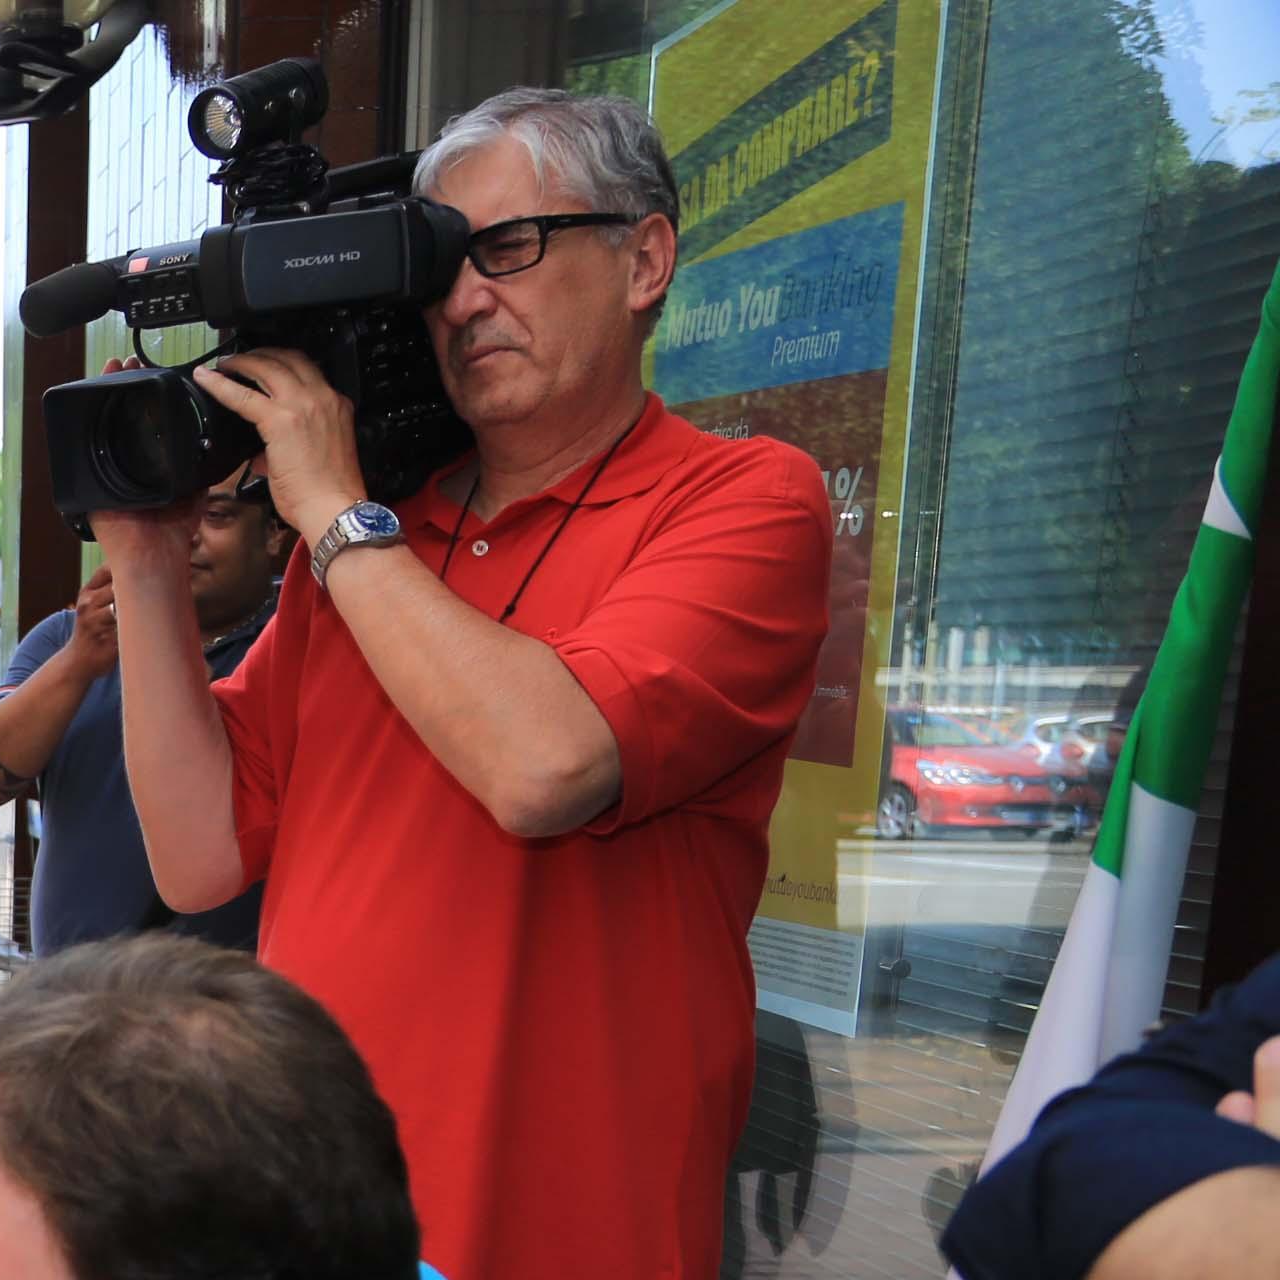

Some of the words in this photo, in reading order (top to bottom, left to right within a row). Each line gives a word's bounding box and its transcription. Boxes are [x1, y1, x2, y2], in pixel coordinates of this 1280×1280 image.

[679, 175, 701, 236] SA
[733, 50, 880, 197] COMPRARE?
[160, 251, 192, 266] SONY
[283, 254, 335, 270] XDCAM
[339, 250, 361, 262] HD
[665, 298, 733, 350] Mutuo
[771, 328, 840, 368] Premium
